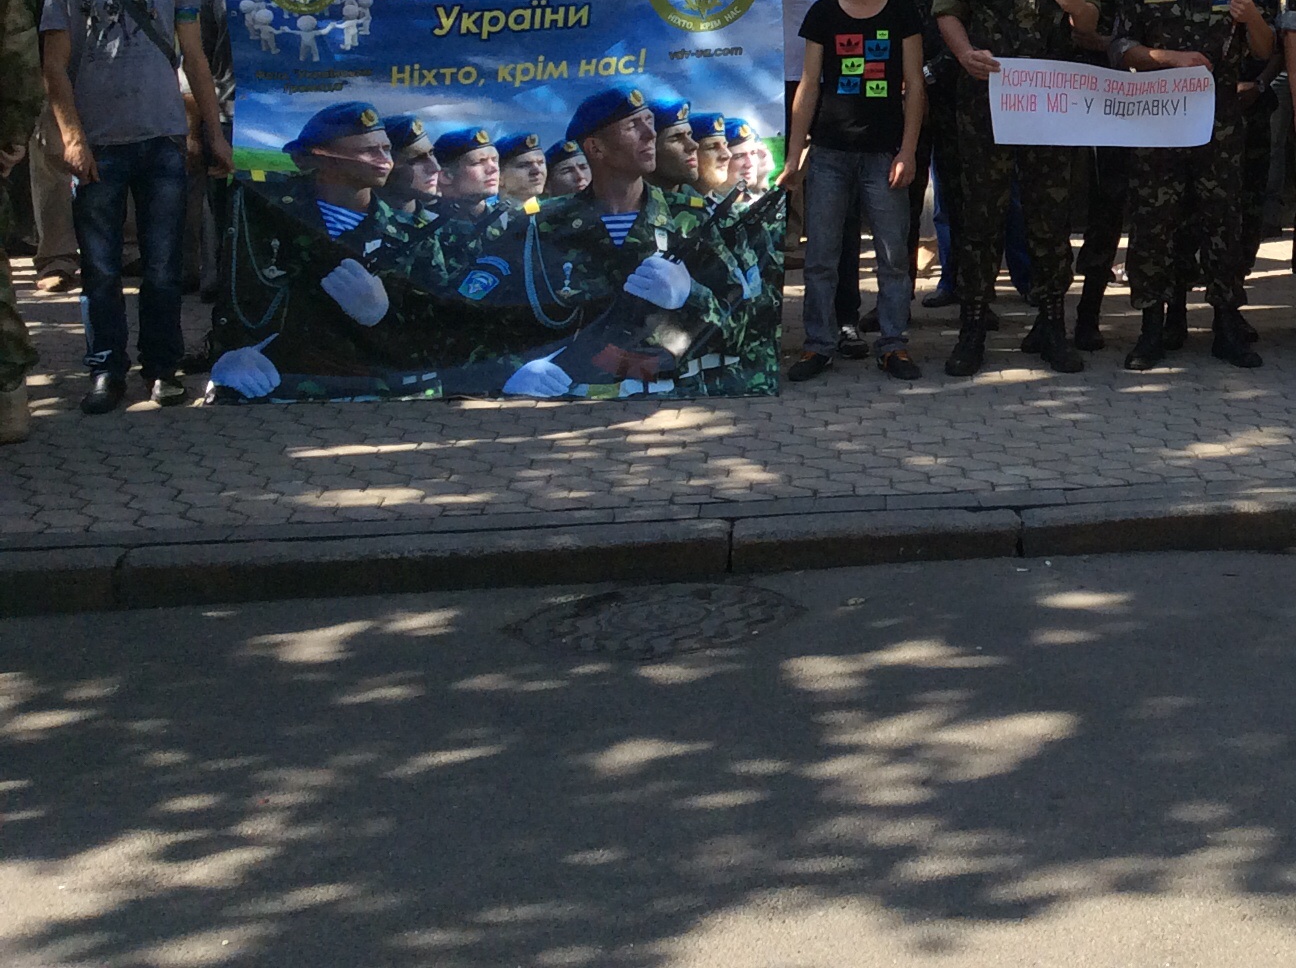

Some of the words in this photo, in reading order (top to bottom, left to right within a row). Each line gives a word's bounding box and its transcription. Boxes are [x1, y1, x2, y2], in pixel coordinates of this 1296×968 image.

[433, 0, 590, 40] України
[723, 5, 742, 22] НАС
[390, 63, 485, 87] Ніхто,
[497, 55, 568, 87] крім
[578, 48, 648, 77] нас!
[1000, 94, 1037, 113] НИКІВ
[1046, 92, 1068, 114] МО
[1083, 97, 1095, 114] У
[1103, 96, 1187, 118] ВІДСТАВКУ!
